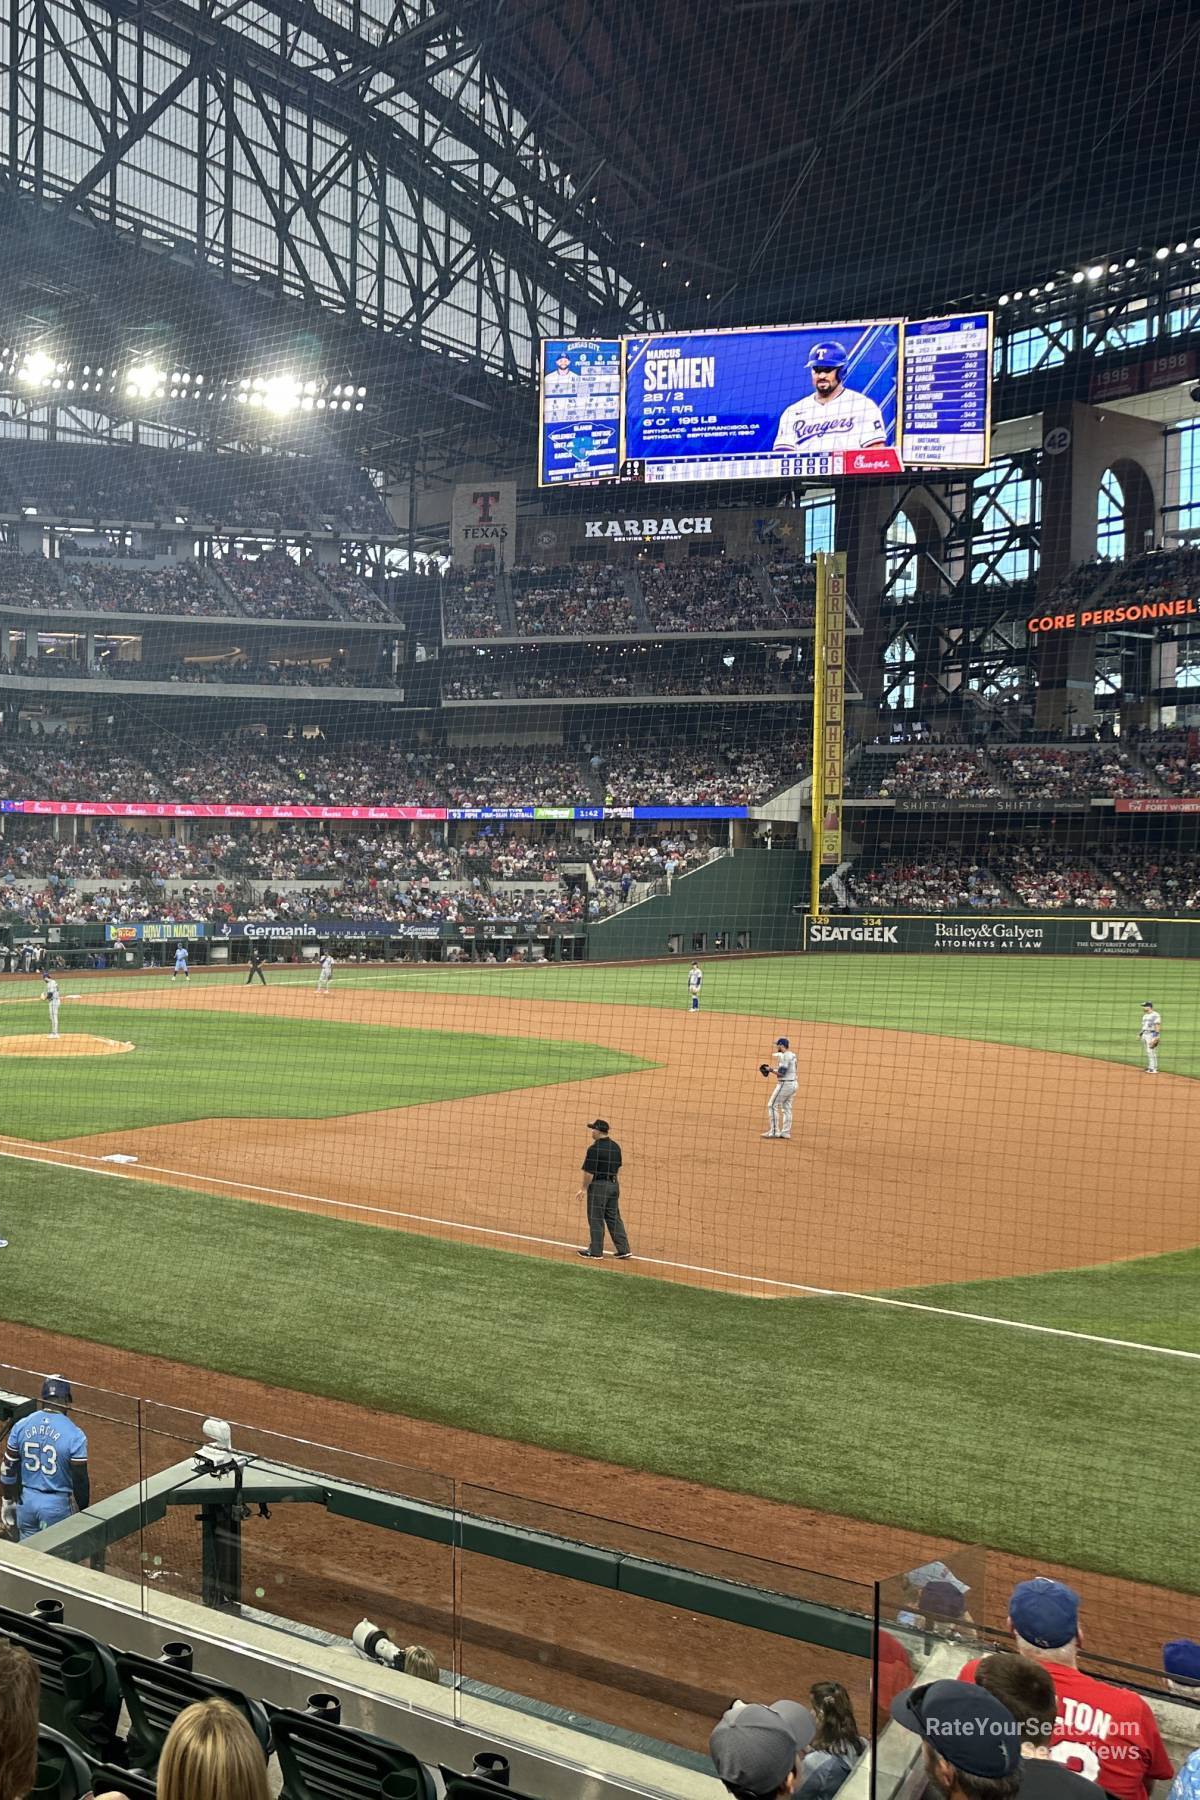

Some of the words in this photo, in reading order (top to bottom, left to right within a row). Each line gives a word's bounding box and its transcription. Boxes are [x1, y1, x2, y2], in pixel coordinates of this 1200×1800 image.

[646, 348, 681, 360] MARCUS
[1153, 353, 1187, 373] 1998
[643, 356, 715, 392] SEMIEN
[1097, 368, 1129, 387] 1996
[915, 383, 931, 392] LOWE
[643, 393, 664, 403] 2B
[673, 392, 684, 401] 2
[643, 406, 666, 416] B/T:
[671, 405, 693, 414] R/R
[678, 417, 699, 425] 195
[700, 415, 717, 424] LB
[793, 417, 856, 438] Rangers
[686, 431, 728, 439] SEPTEMBER
[1047, 433, 1068, 450] 42
[633, 468, 640, 476] 1
[472, 491, 501, 524] T
[462, 527, 508, 539] TEXAS
[585, 517, 713, 538] KARBACH
[830, 580, 840, 664] BRING
[1028, 613, 1076, 633] CORE
[1079, 599, 1197, 627] PERSONNEL
[829, 671, 838, 720] THE
[827, 728, 838, 794] HEAT
[902, 801, 937, 810] SHIFT
[997, 801, 1033, 810] SHIFT
[1145, 803, 1168, 811] FORT
[243, 923, 317, 936] Germania
[811, 916, 830, 925] 329
[862, 918, 882, 926] 334
[143, 924, 161, 938] HOW
[163, 924, 172, 937] TO
[810, 925, 899, 943] SEATGEEK
[935, 923, 1044, 941] Bailey&Galyen
[1090, 921, 1143, 941] UTA
[934, 940, 995, 948] ATTORNEYS
[1001, 940, 1014, 948] AT
[1019, 940, 1042, 948] LAW
[24, 1424, 60, 1442] GARCIA
[24, 1441, 58, 1476] 53
